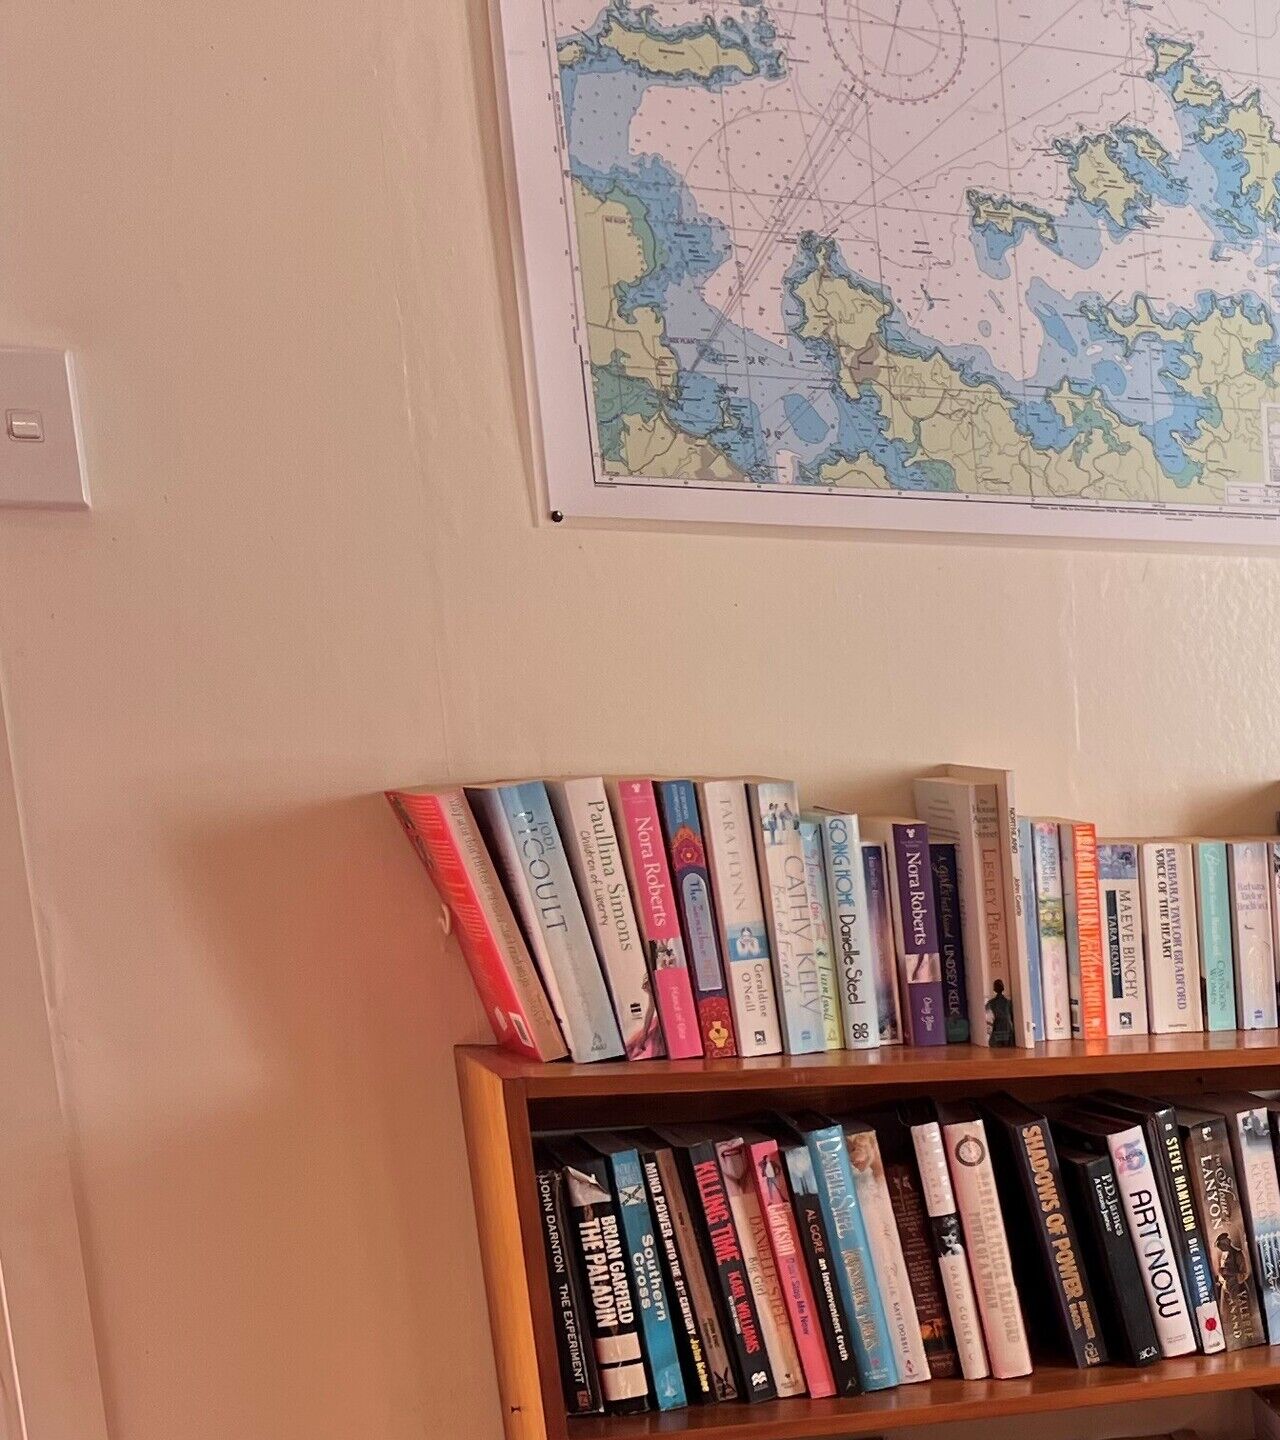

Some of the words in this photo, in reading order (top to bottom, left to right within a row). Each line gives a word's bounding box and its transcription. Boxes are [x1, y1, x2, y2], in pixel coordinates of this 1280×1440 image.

[719, 799, 736, 843] TARA
[829, 819, 851, 865] GOING
[513, 810, 567, 932] PICOULT
[588, 801, 616, 877] Paullina
[607, 884, 632, 951] Simons
[634, 817, 652, 858] Nora
[650, 863, 669, 926] Roberts
[836, 870, 855, 908] HOME
[905, 852, 923, 888] Nora
[982, 849, 998, 908] LESLEY
[1155, 848, 1167, 879] VOICE
[1157, 882, 1168, 896] OF
[1166, 848, 1180, 903] BARBARA
[592, 889, 608, 926] Liberty
[784, 855, 812, 942] CATHY
[909, 891, 928, 945] Roberts
[1119, 889, 1136, 942] MAEVE
[1159, 897, 1170, 919] THE
[839, 915, 859, 964] Danielle
[987, 912, 1002, 969] PEARSE
[1108, 915, 1118, 942] TARA
[1161, 923, 1172, 960] HEART
[1171, 907, 1183, 948] TAYLOR
[796, 952, 820, 1013] KELLY
[846, 968, 865, 1005] Steel
[1109, 945, 1121, 976] ROAD
[1124, 947, 1138, 999] BINCHY
[1173, 950, 1187, 1010] BRADFORD
[754, 964, 769, 1018] Geraldine
[1022, 1125, 1060, 1212] SHADOWS
[1166, 1137, 1183, 1173] STEVE
[538, 1176, 554, 1212] JOHN
[694, 1160, 729, 1224] KILLING
[1129, 1190, 1162, 1240] ART
[1173, 1175, 1196, 1232] HAMILTON
[1200, 1154, 1224, 1230] LANYON
[546, 1215, 565, 1273] DARNTON
[579, 1217, 600, 1251] THE
[645, 1162, 662, 1193] MIND
[654, 1196, 673, 1238] POWER
[676, 1296, 696, 1335] CENTURY
[710, 1223, 740, 1265] TIME
[1046, 1213, 1068, 1236] OF
[1187, 1238, 1199, 1254] DIE
[559, 1283, 571, 1307] THE
[585, 1252, 618, 1328] PALADIN
[600, 1215, 619, 1259] BRIAN
[610, 1261, 634, 1324] GARFIELD
[632, 1252, 651, 1309] Cross
[641, 1234, 667, 1321] Southern
[727, 1270, 742, 1298] KARL
[748, 1215, 776, 1280] DANIELLE
[766, 1287, 787, 1330] STEEL
[753, 1276, 766, 1296] Girl
[767, 1202, 796, 1257] Clarkson
[798, 1316, 810, 1336] Now
[808, 1224, 823, 1254] GORE
[820, 1272, 842, 1334] inconvenient
[835, 1335, 849, 1362] truth
[1050, 1237, 1083, 1301] POWER
[1144, 1249, 1180, 1319] NOW
[563, 1310, 584, 1384] EXPERIMENT
[736, 1300, 759, 1355] WILLIAMS
